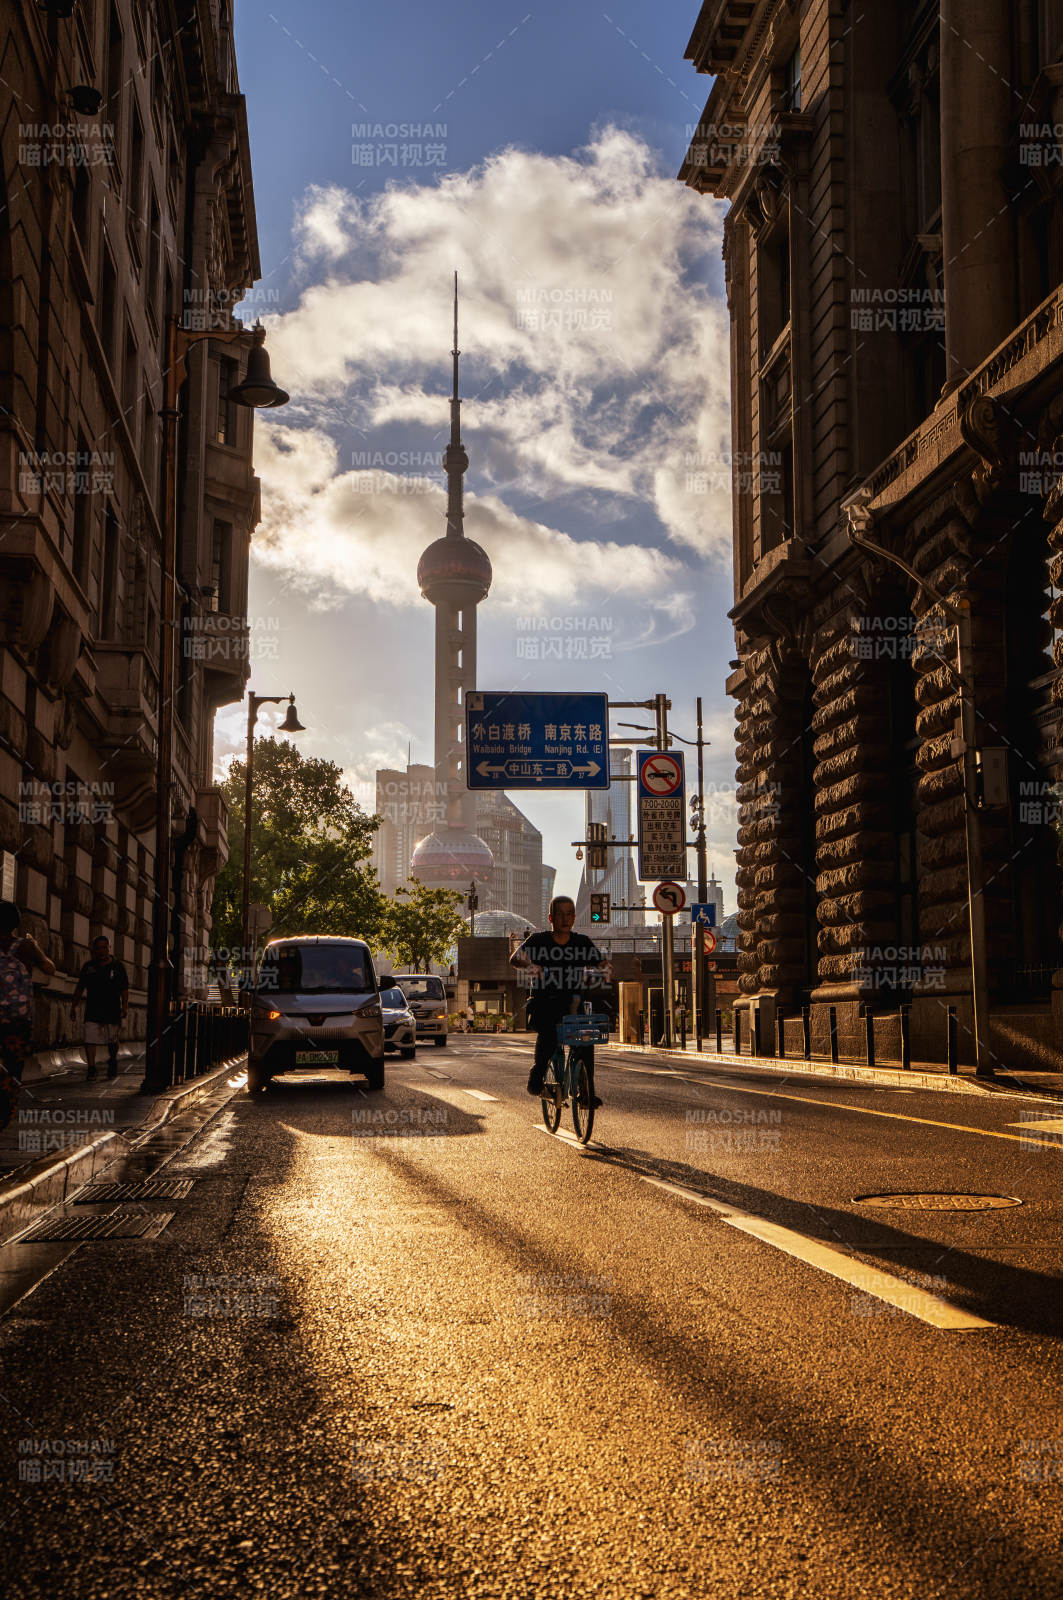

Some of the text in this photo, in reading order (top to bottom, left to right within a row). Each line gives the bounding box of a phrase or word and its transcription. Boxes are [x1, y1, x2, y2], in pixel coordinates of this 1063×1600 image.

[472, 723, 603, 741] 外白渡桥 南京东路
[473, 744, 505, 753] Waibaidu
[509, 744, 532, 755] Bridge
[544, 745, 572, 755] Nanjing
[576, 745, 589, 753] Rd.
[509, 763, 567, 775] 中山东一路
